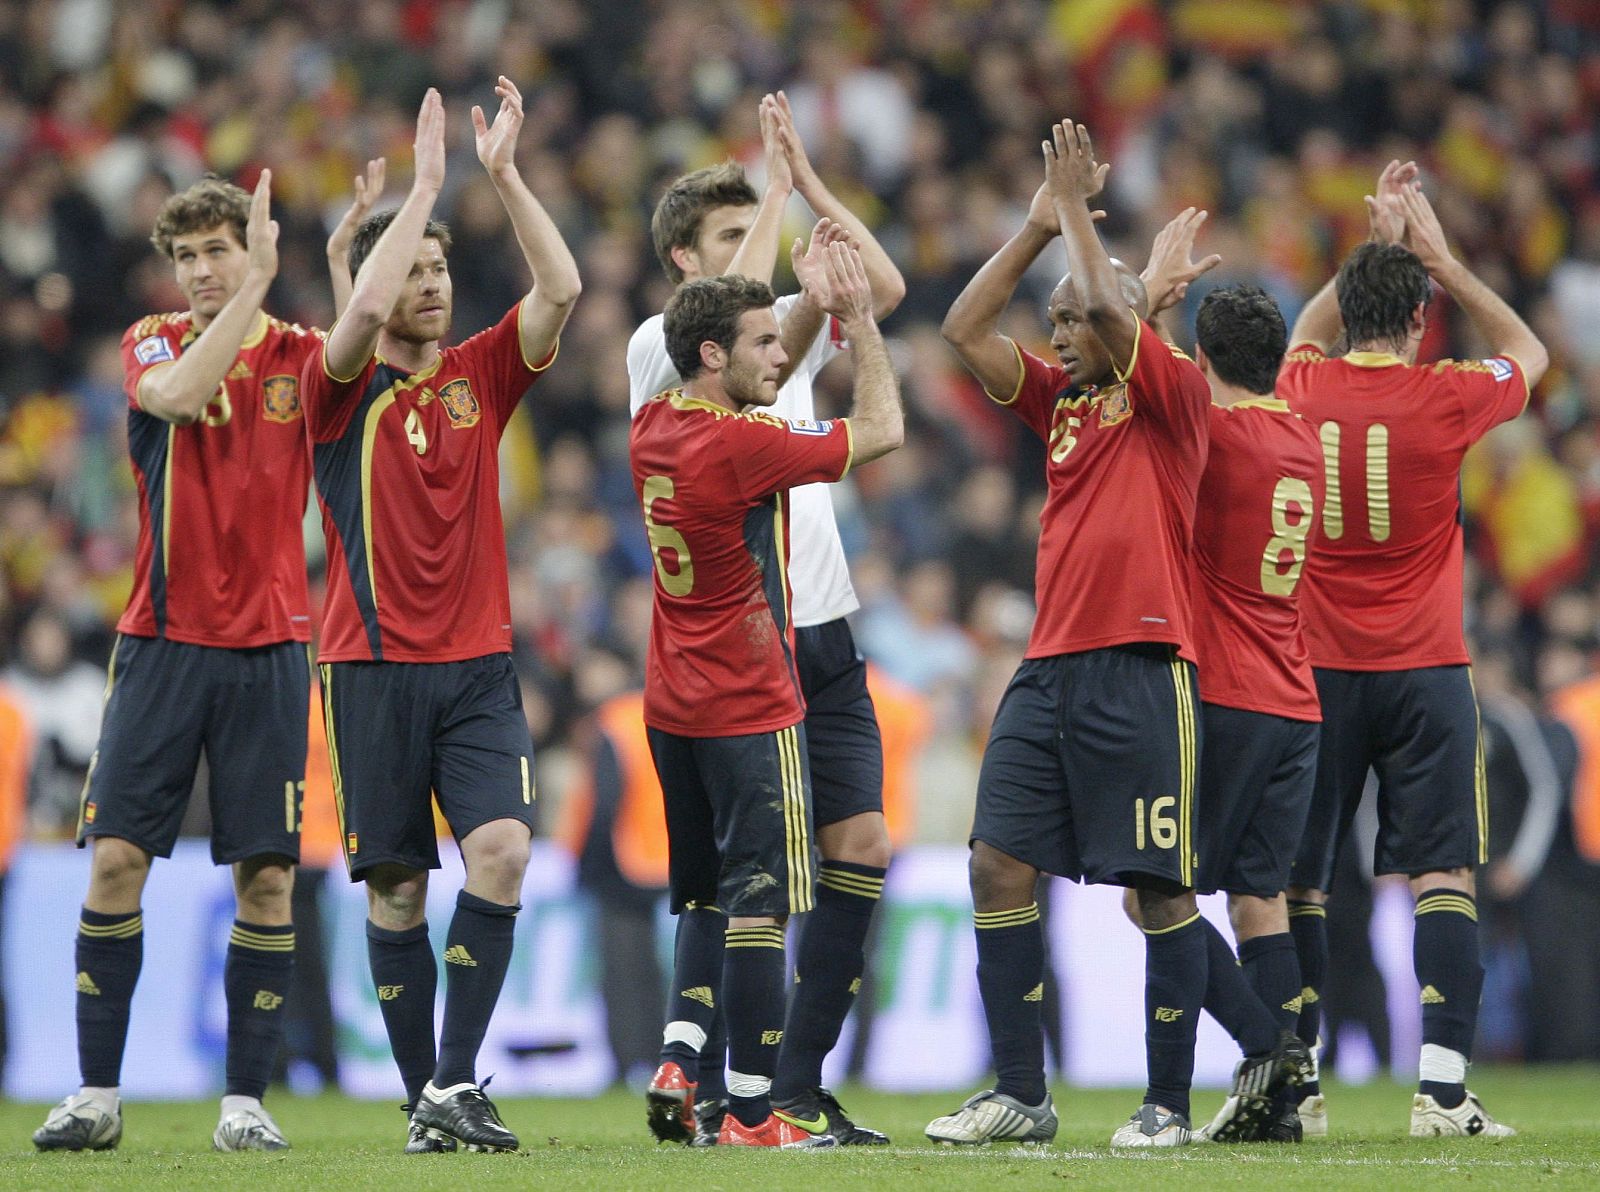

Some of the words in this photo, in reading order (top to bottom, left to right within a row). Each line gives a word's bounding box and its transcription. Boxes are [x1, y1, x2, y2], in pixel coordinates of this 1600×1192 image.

[1319, 421, 1391, 542] 11
[643, 475, 694, 597] 6
[1260, 477, 1313, 597] 8
[285, 780, 304, 833] 1
[520, 756, 536, 805] 1
[1135, 796, 1177, 850] 16
